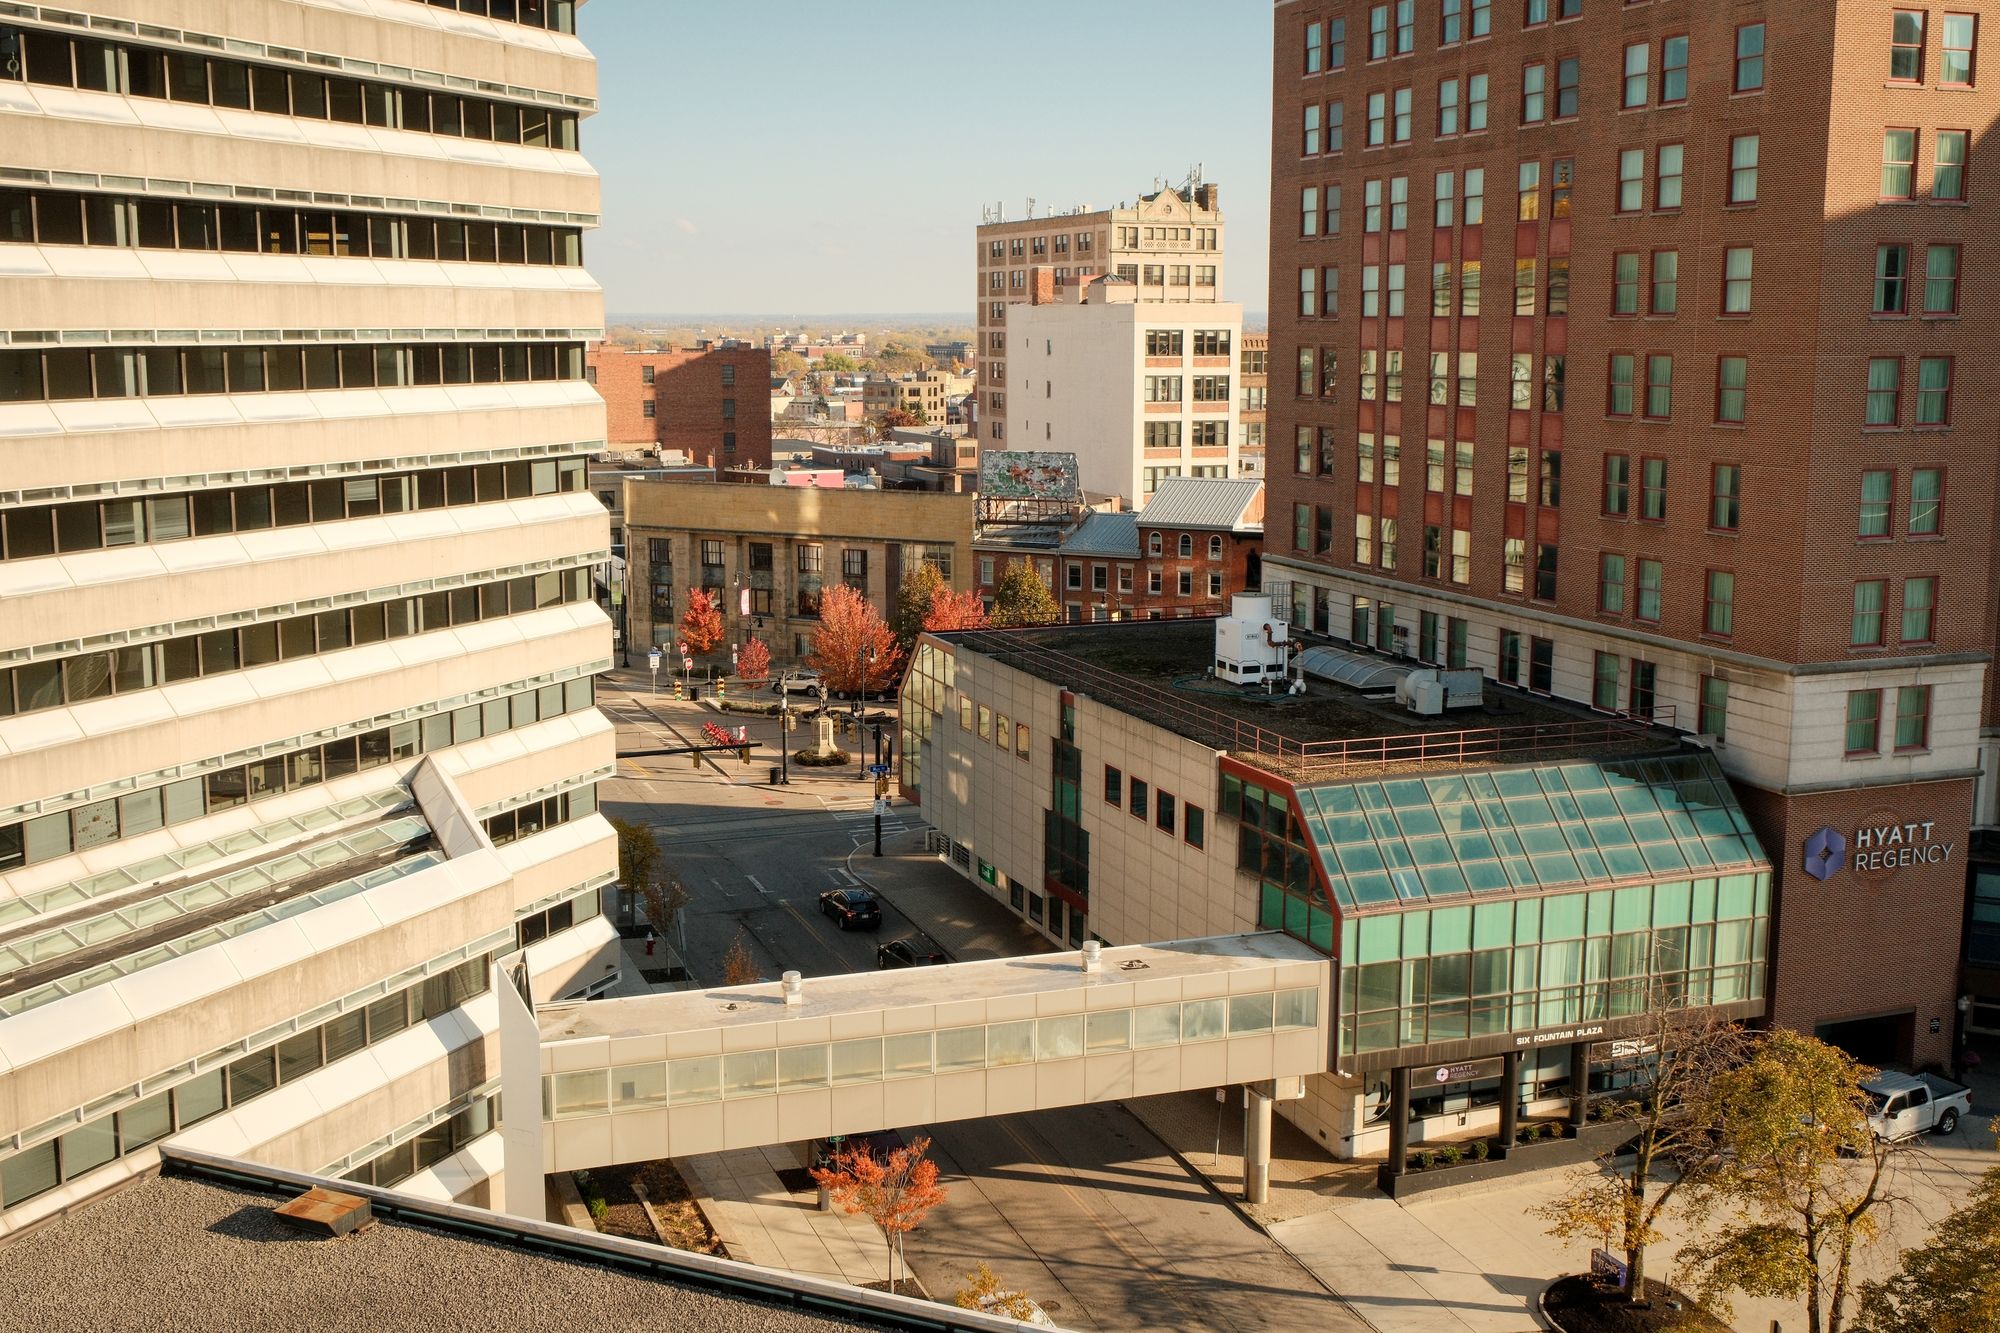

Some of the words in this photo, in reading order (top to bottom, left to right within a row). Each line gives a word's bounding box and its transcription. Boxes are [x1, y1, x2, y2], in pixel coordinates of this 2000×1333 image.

[1857, 822, 1935, 849] HYATT
[1855, 843, 1954, 872] REGENCY
[1516, 1036, 1531, 1045] SIX
[1534, 1030, 1574, 1042] FOUNTAIN
[1577, 1026, 1603, 1037] PLAZA
[1450, 1064, 1473, 1073] HYATT
[1450, 1070, 1479, 1079] REGENCY
